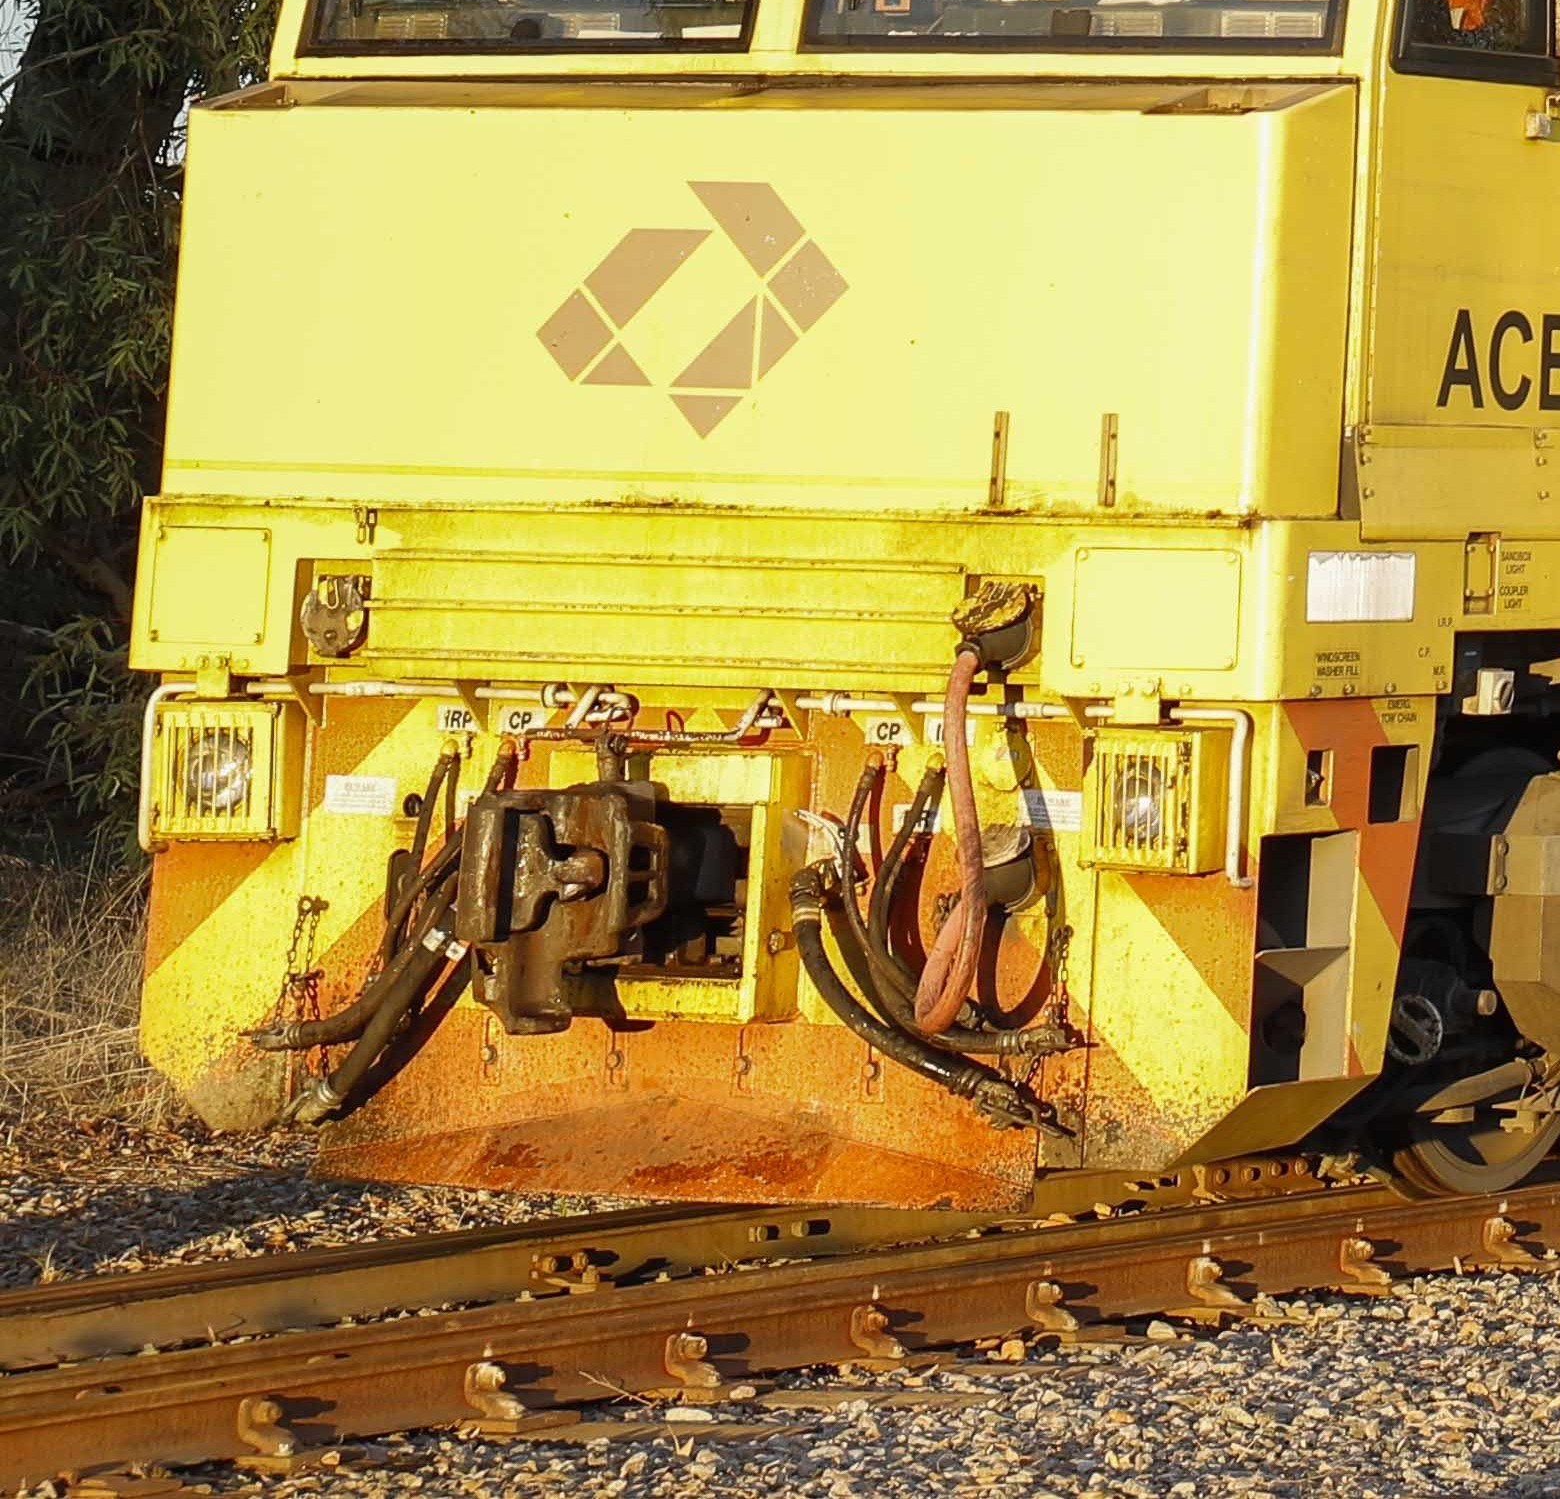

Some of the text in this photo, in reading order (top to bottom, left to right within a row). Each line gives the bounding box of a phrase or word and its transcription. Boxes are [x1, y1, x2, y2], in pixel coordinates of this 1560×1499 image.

[1505, 563, 1526, 575] LIGHT
[1499, 585, 1529, 596] COUPLER
[1503, 598, 1523, 609] LIGHT
[1315, 651, 1360, 663] WINDSCREEN
[1316, 665, 1359, 677] WASHER FILL
[509, 711, 532, 729] CP
[1397, 712, 1417, 723] CHAIN
[877, 723, 900, 740] CP
